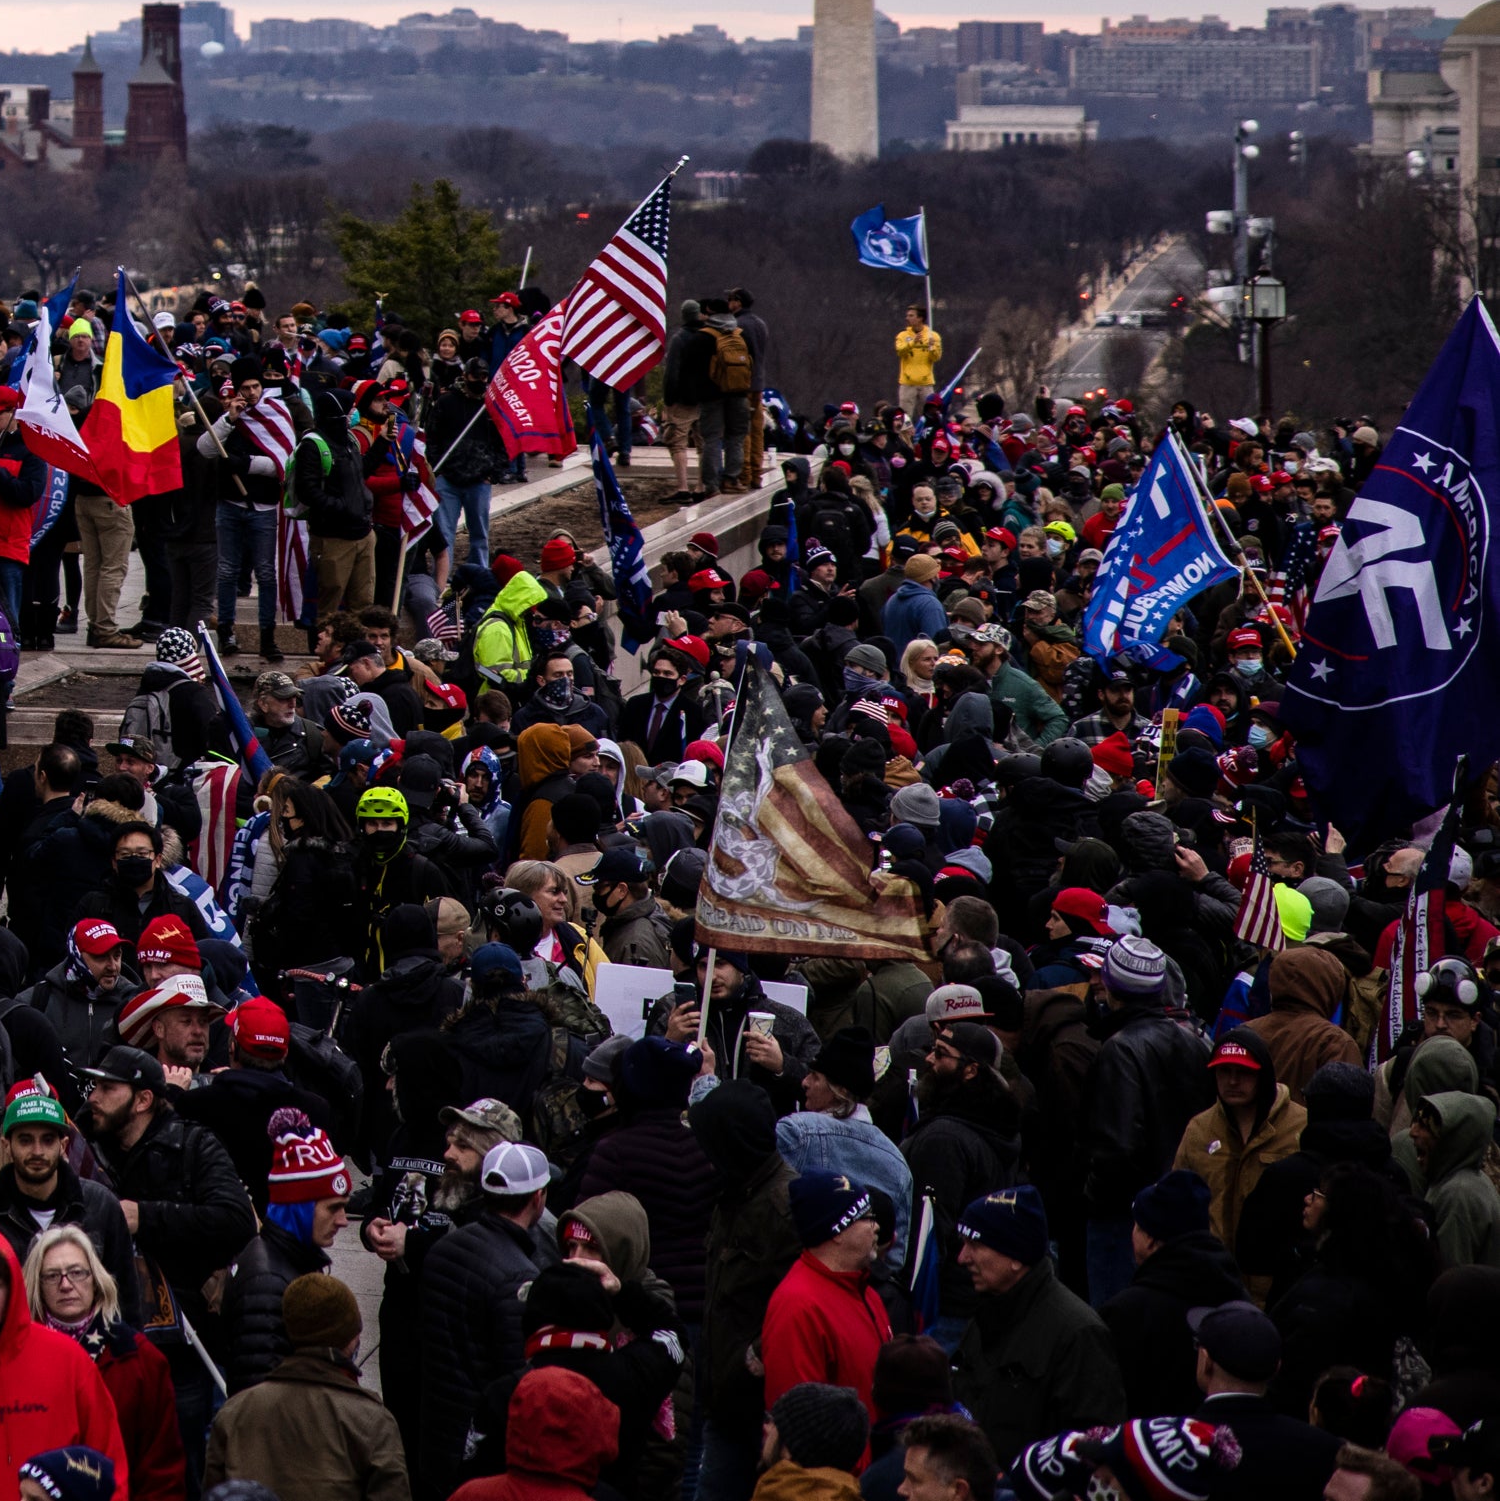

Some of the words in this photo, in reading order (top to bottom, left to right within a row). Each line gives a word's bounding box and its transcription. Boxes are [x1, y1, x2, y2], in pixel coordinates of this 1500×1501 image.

[1220, 1046, 1248, 1056] GREAT
[431, 1163, 446, 1175] BAC
[334, 1177, 347, 1190] 45
[1148, 1416, 1199, 1471] UMP
